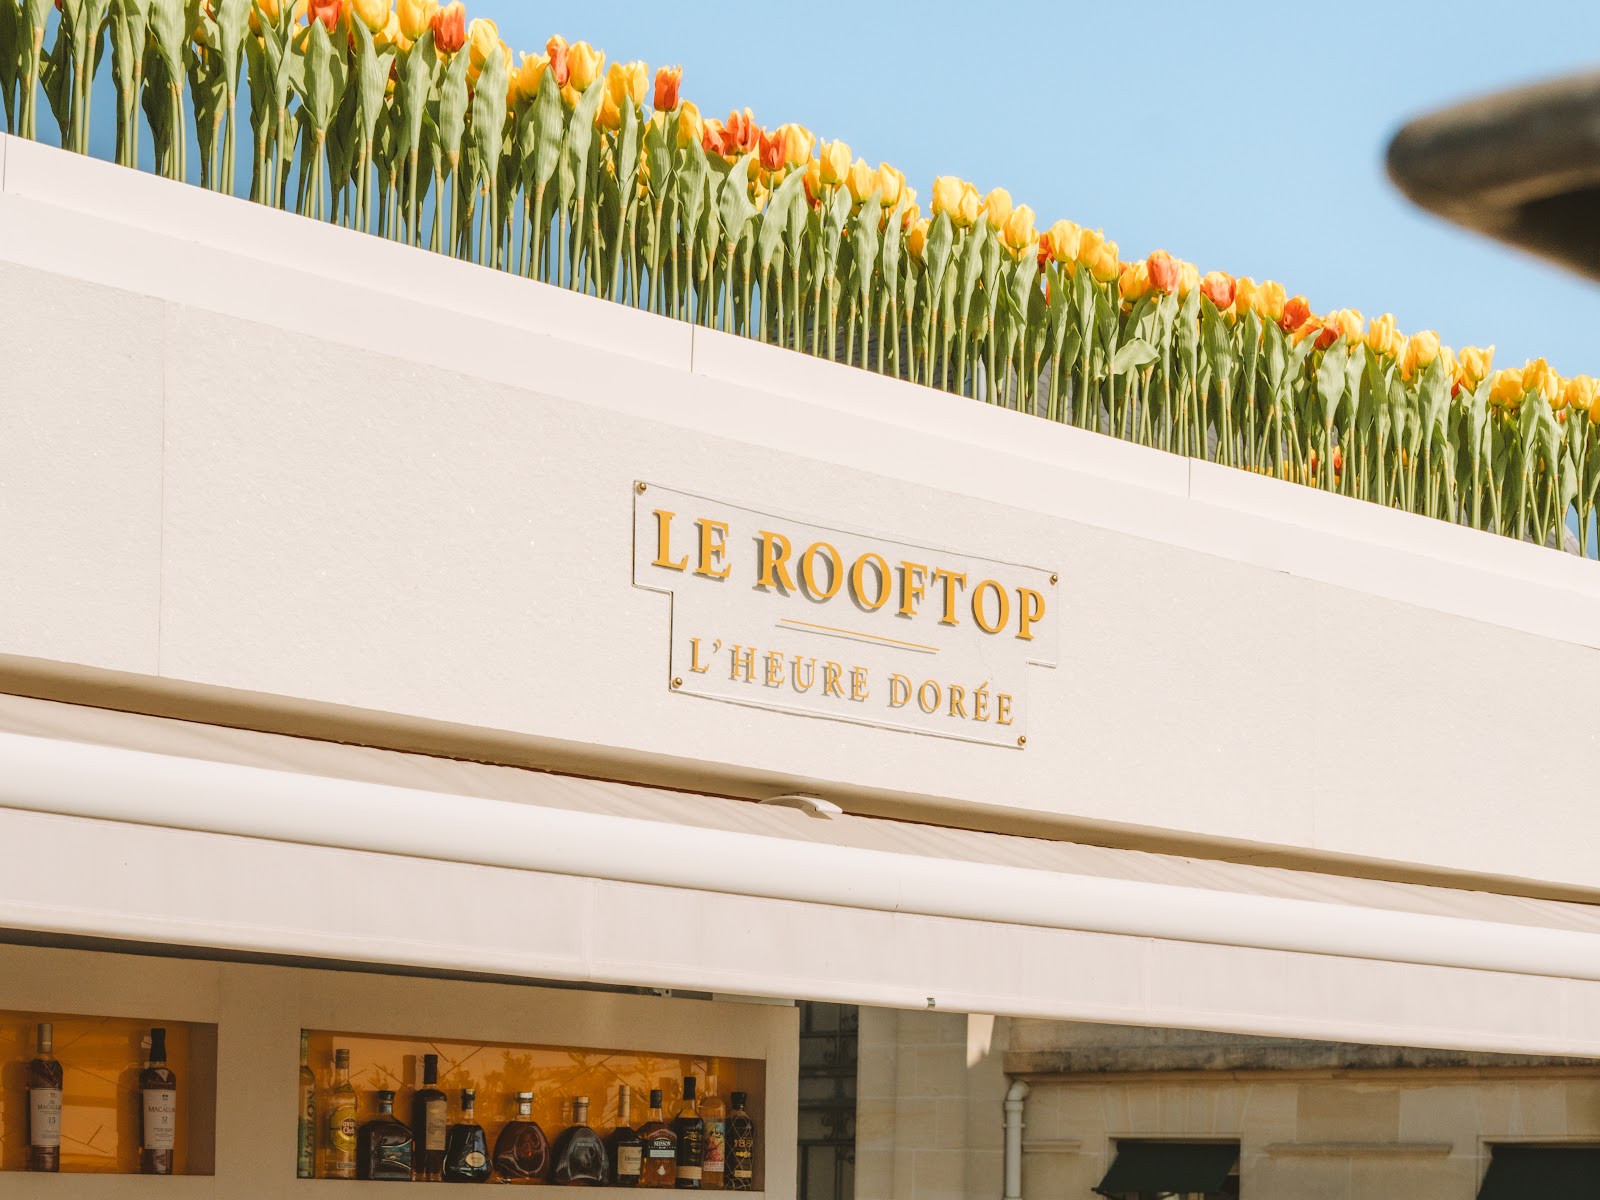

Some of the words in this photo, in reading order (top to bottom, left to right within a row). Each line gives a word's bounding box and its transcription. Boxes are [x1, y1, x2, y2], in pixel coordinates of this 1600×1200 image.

[651, 508, 732, 580] LE
[756, 529, 1046, 641] ROOFTOP
[890, 672, 1014, 726] DORÉE
